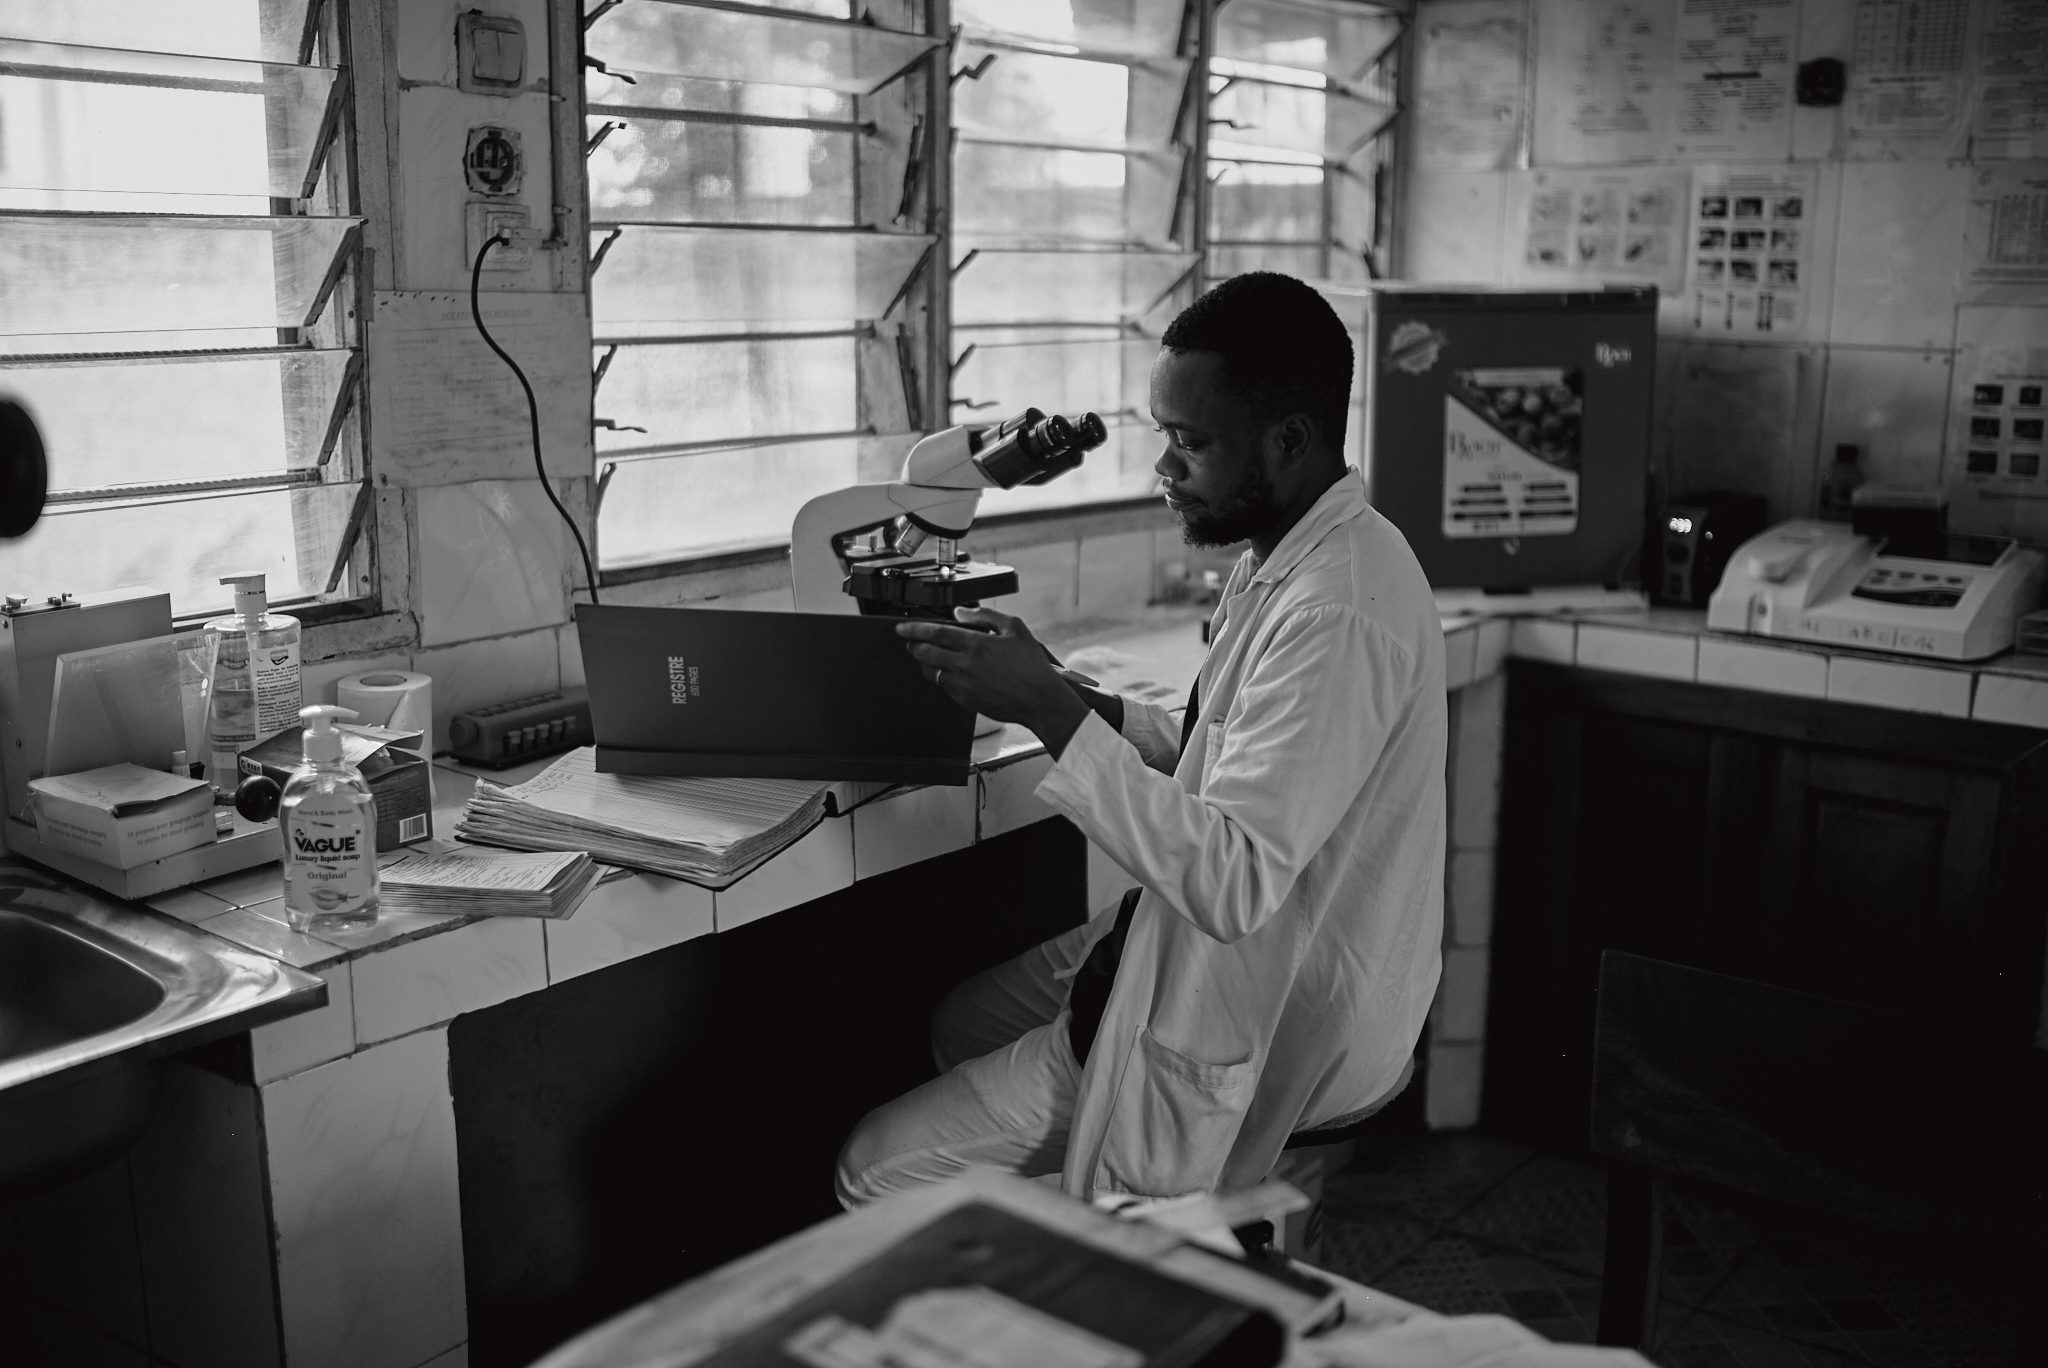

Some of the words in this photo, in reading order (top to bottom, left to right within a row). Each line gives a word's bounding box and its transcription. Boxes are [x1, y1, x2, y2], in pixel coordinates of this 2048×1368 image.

[668, 656, 688, 704] REGISTRE
[689, 666, 700, 685] PAGES
[690, 685, 700, 697] 600
[320, 809, 336, 817] Body
[337, 808, 354, 816] Wash
[294, 836, 356, 853] VAGUE
[295, 854, 319, 863] Luxury
[320, 854, 341, 863] liquid
[342, 853, 361, 861] soap
[307, 871, 347, 881] Original
